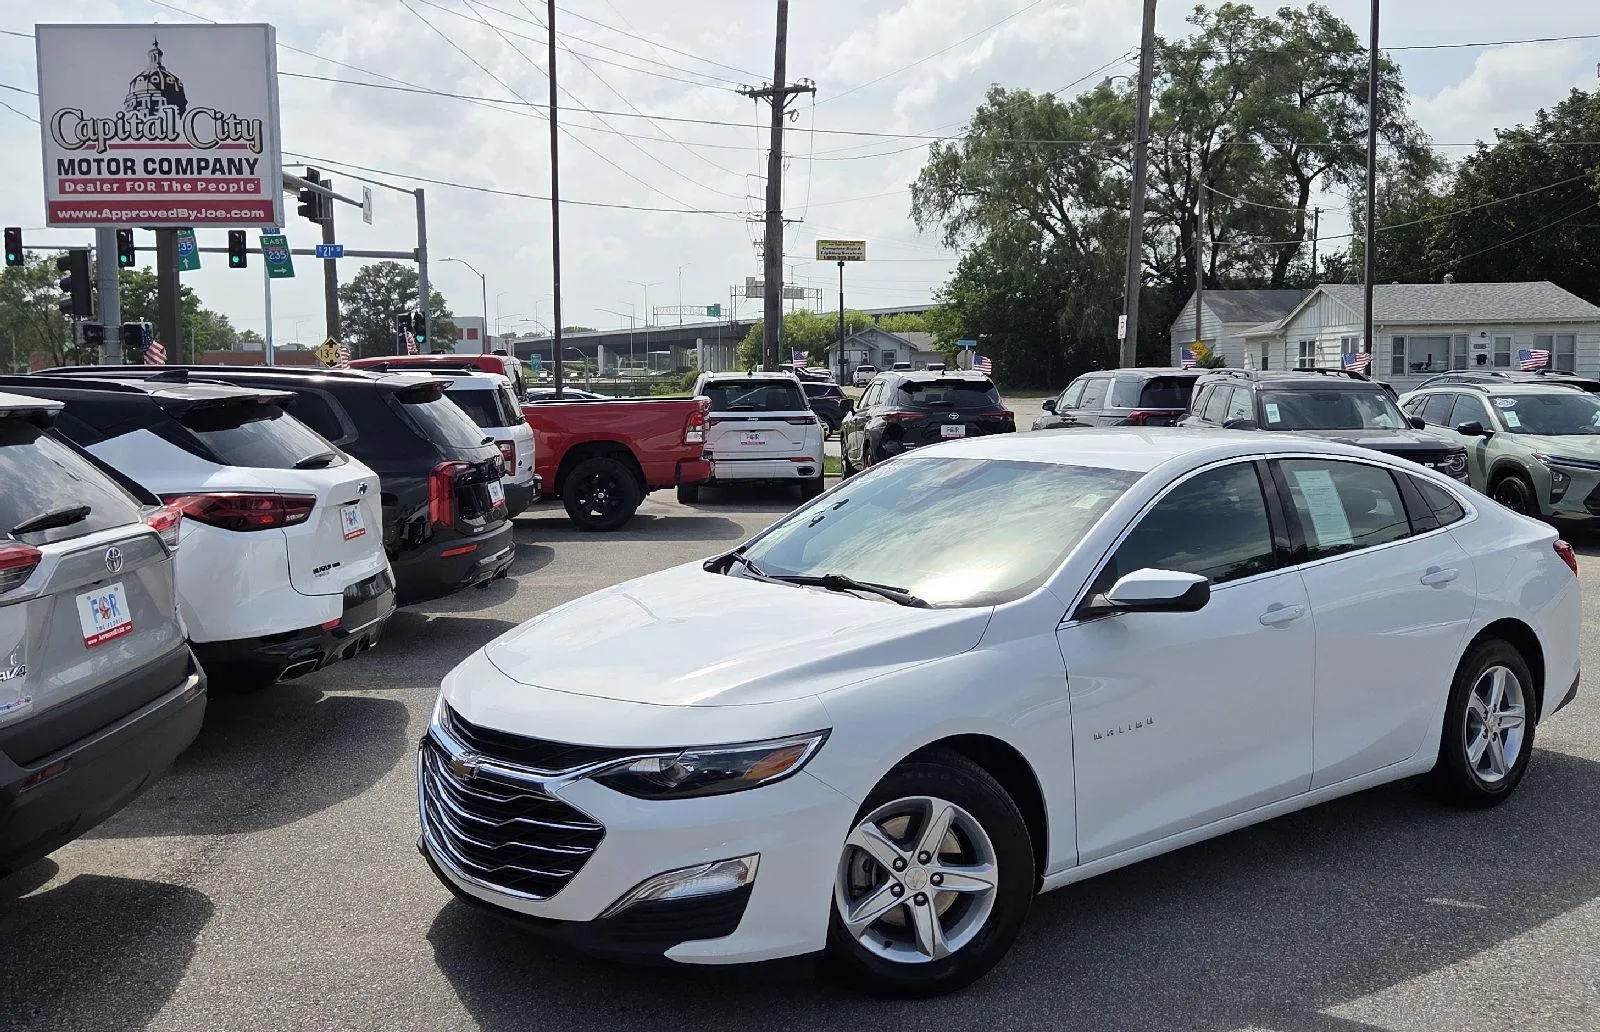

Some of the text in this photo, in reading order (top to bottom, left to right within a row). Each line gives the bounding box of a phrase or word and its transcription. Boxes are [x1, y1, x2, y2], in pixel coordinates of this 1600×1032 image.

[51, 107, 263, 154] Capital City
[57, 158, 259, 176] MOTOR COMPANY
[65, 181, 255, 193] Dealer FOR The People
[57, 208, 265, 220] www.ApprovedByJoe.com
[268, 250, 287, 260] 235
[320, 348, 340, 359] 13-6
[0, 664, 27, 682] AV4
[1093, 716, 1155, 741] MALIBU
